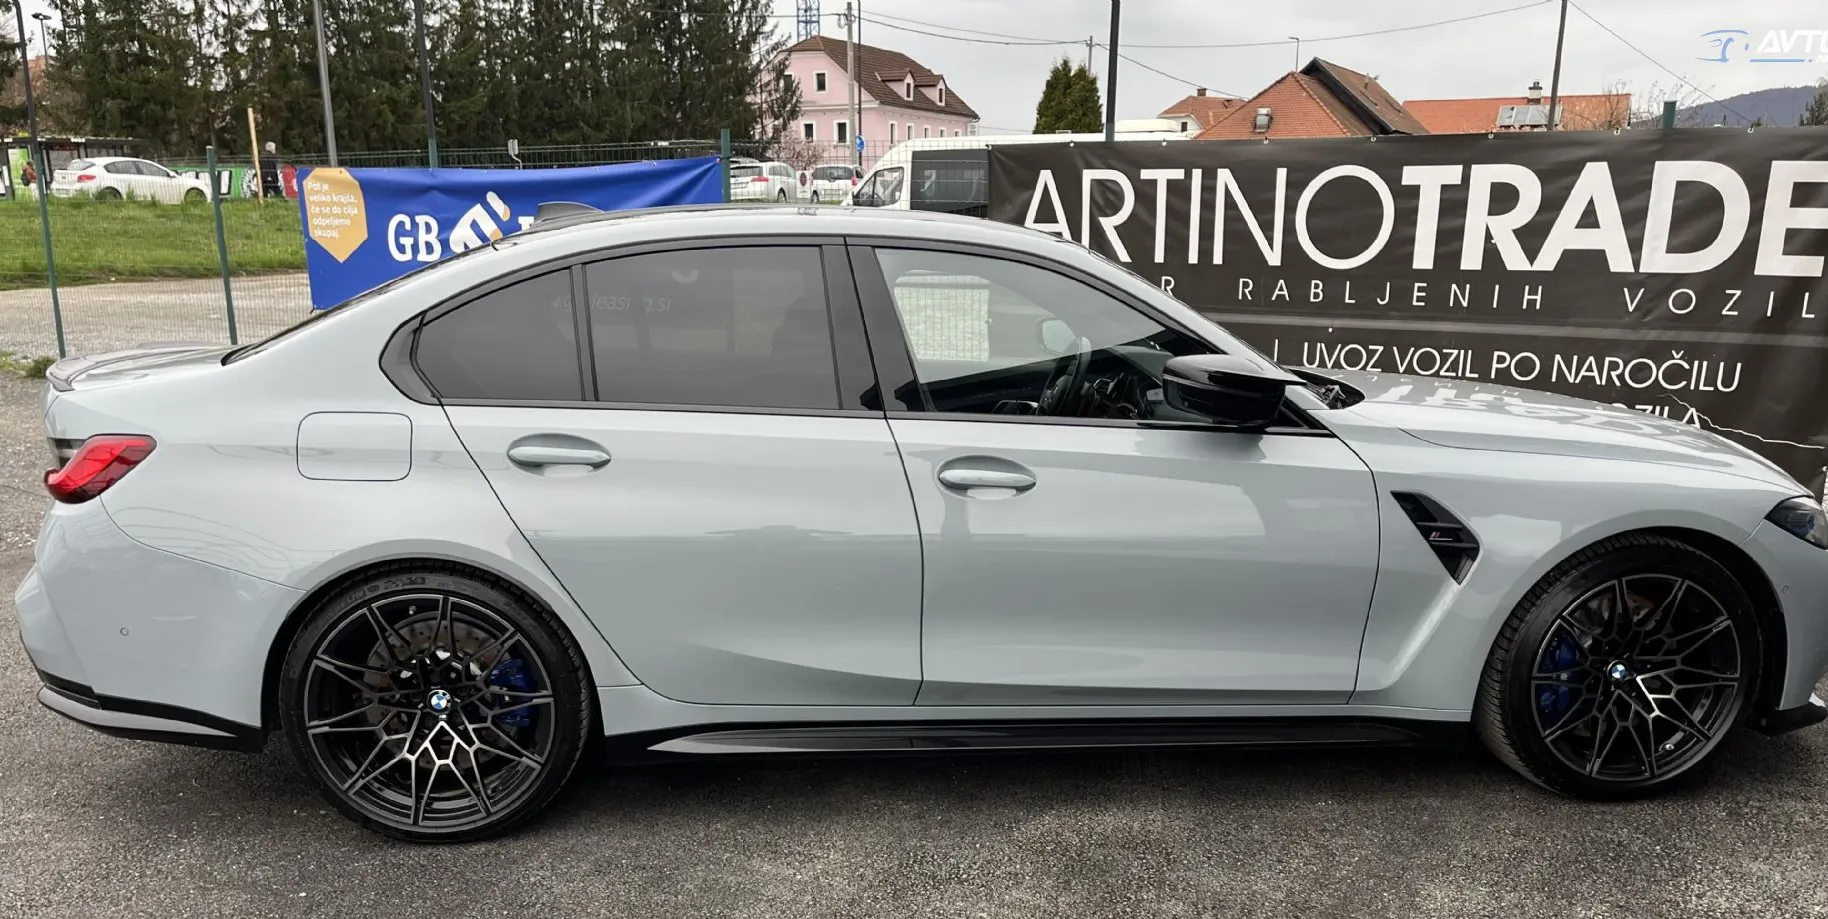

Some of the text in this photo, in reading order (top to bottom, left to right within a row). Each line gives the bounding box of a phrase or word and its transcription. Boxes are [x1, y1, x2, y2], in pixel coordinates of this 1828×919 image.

[322, 182, 330, 191] je
[309, 193, 331, 202] veliko
[332, 206, 342, 214] do
[343, 206, 358, 216] cilja
[312, 216, 351, 226] odpeljemo
[387, 213, 442, 262] GB
[1238, 277, 1543, 310] RABLJENIH
[1623, 287, 1816, 319] VOZIL
[1302, 341, 1385, 372] UVOZ
[1392, 346, 1479, 378] VOZIL
[1490, 350, 1541, 381] PO
[1551, 349, 1742, 392] NAROČILU
